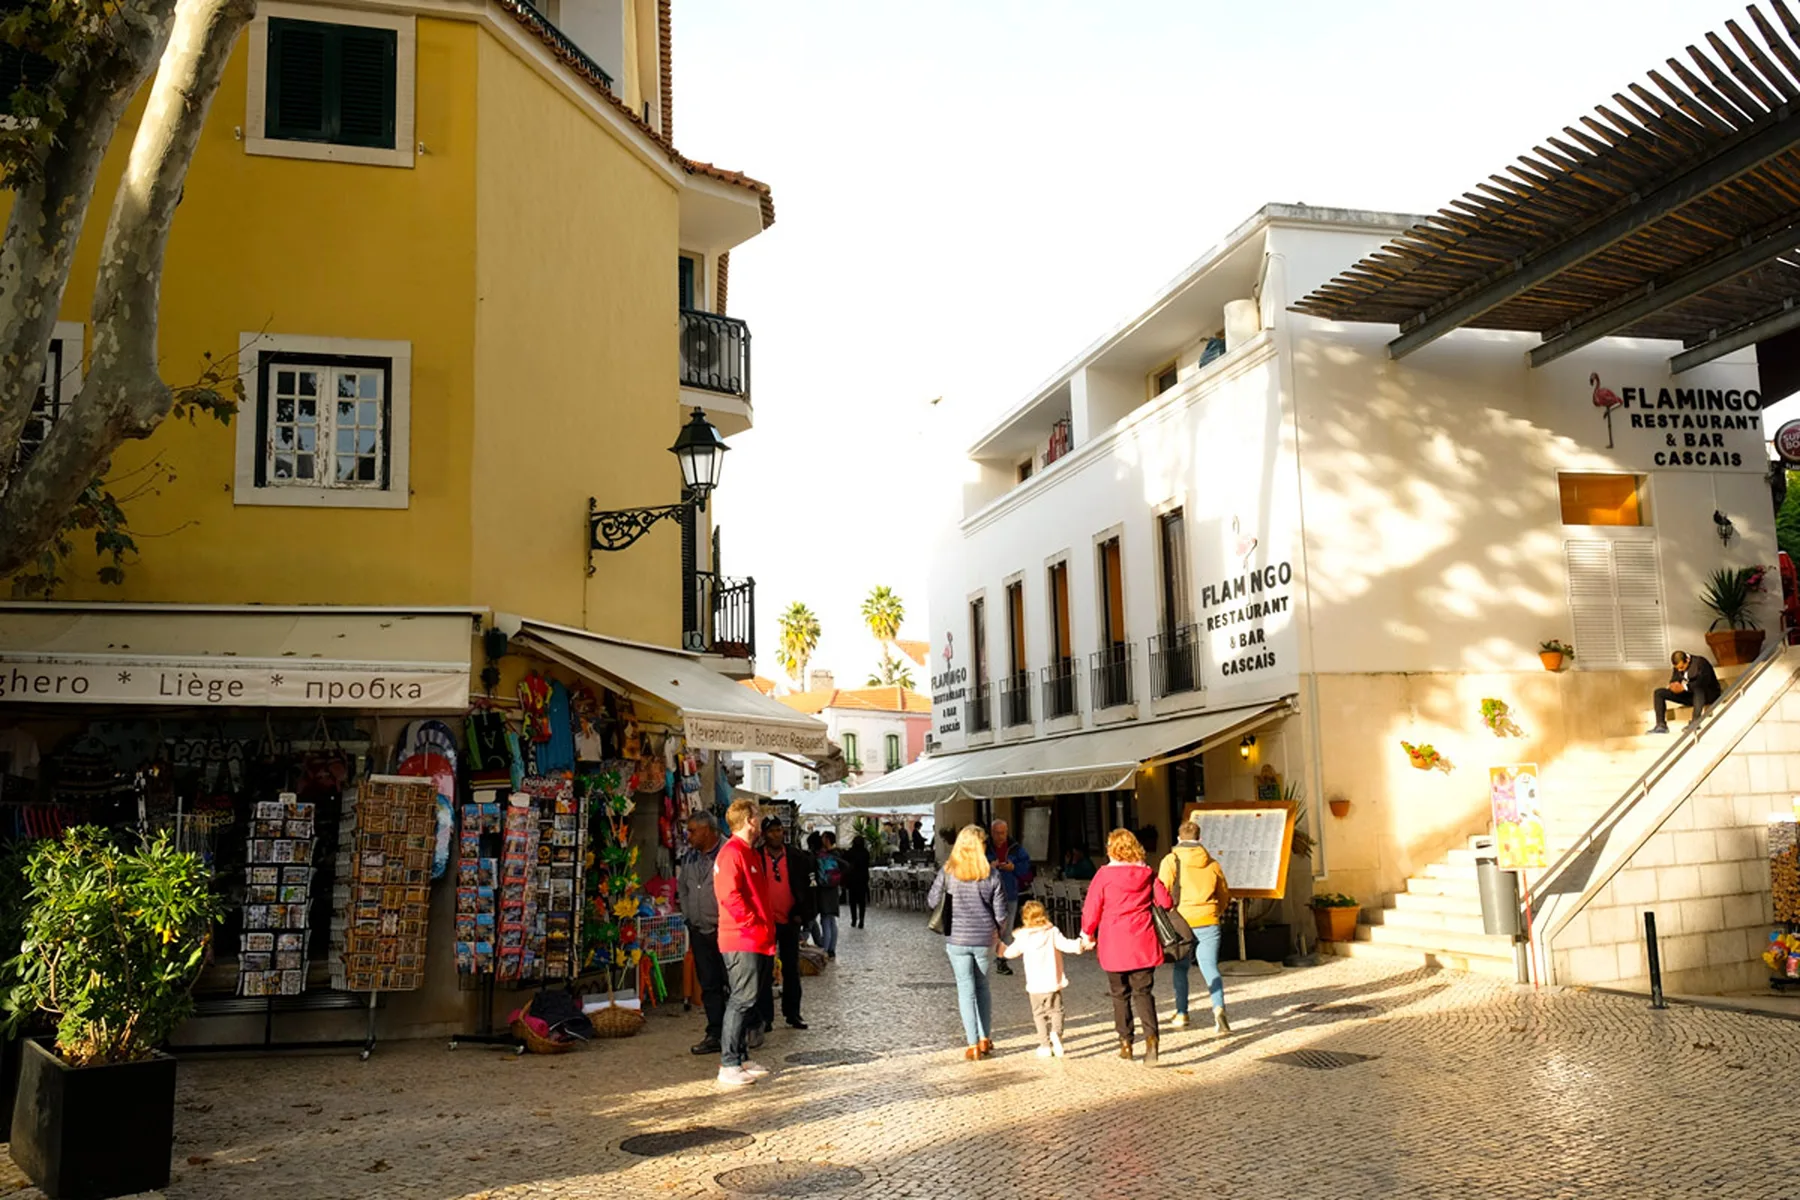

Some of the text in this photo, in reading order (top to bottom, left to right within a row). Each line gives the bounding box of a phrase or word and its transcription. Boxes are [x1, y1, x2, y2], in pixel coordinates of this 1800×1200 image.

[1622, 387, 1763, 411] FLAMINGO
[1631, 414, 1760, 430] RESTAURANT
[1666, 433, 1724, 447] & BAR
[1654, 451, 1743, 467] CASCAIS
[1201, 561, 1292, 609] FLAMNGO
[1206, 596, 1289, 632] RESTAURANT
[1239, 628, 1265, 648] BAR
[159, 672, 244, 703] Liège
[305, 676, 423, 704] пробка
